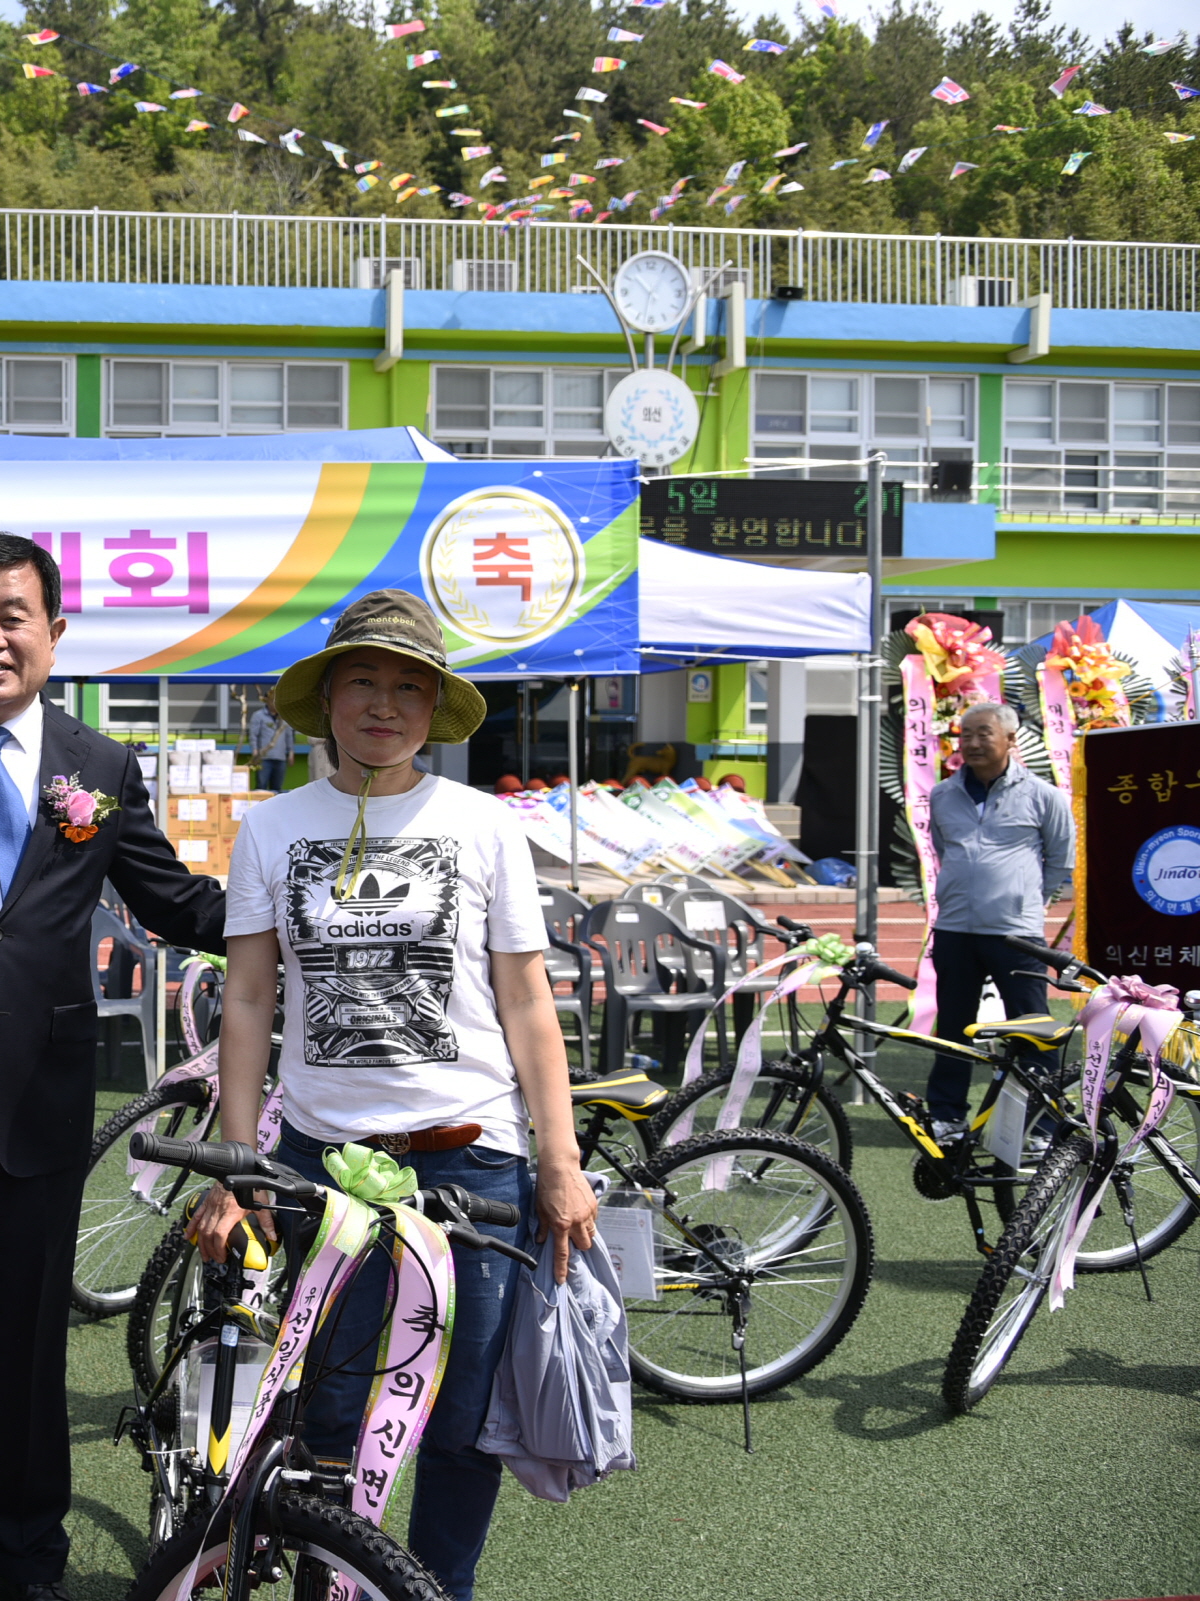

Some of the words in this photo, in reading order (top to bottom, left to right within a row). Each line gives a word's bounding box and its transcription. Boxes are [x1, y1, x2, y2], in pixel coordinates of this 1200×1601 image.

[642, 406, 662, 422] 의신
[667, 481, 718, 515] 5일
[710, 517, 867, 548] 환영합니다
[472, 532, 532, 602] 축
[373, 853, 386, 861] THE
[386, 856, 411, 868] LEGEND
[1135, 830, 1176, 876] Uisin-myeon
[1154, 867, 1200, 881] Jindo
[327, 919, 412, 938] adidas
[345, 949, 396, 968] 1972
[349, 1013, 398, 1025] ORIGINALS
[361, 1371, 426, 1508] 의신면
